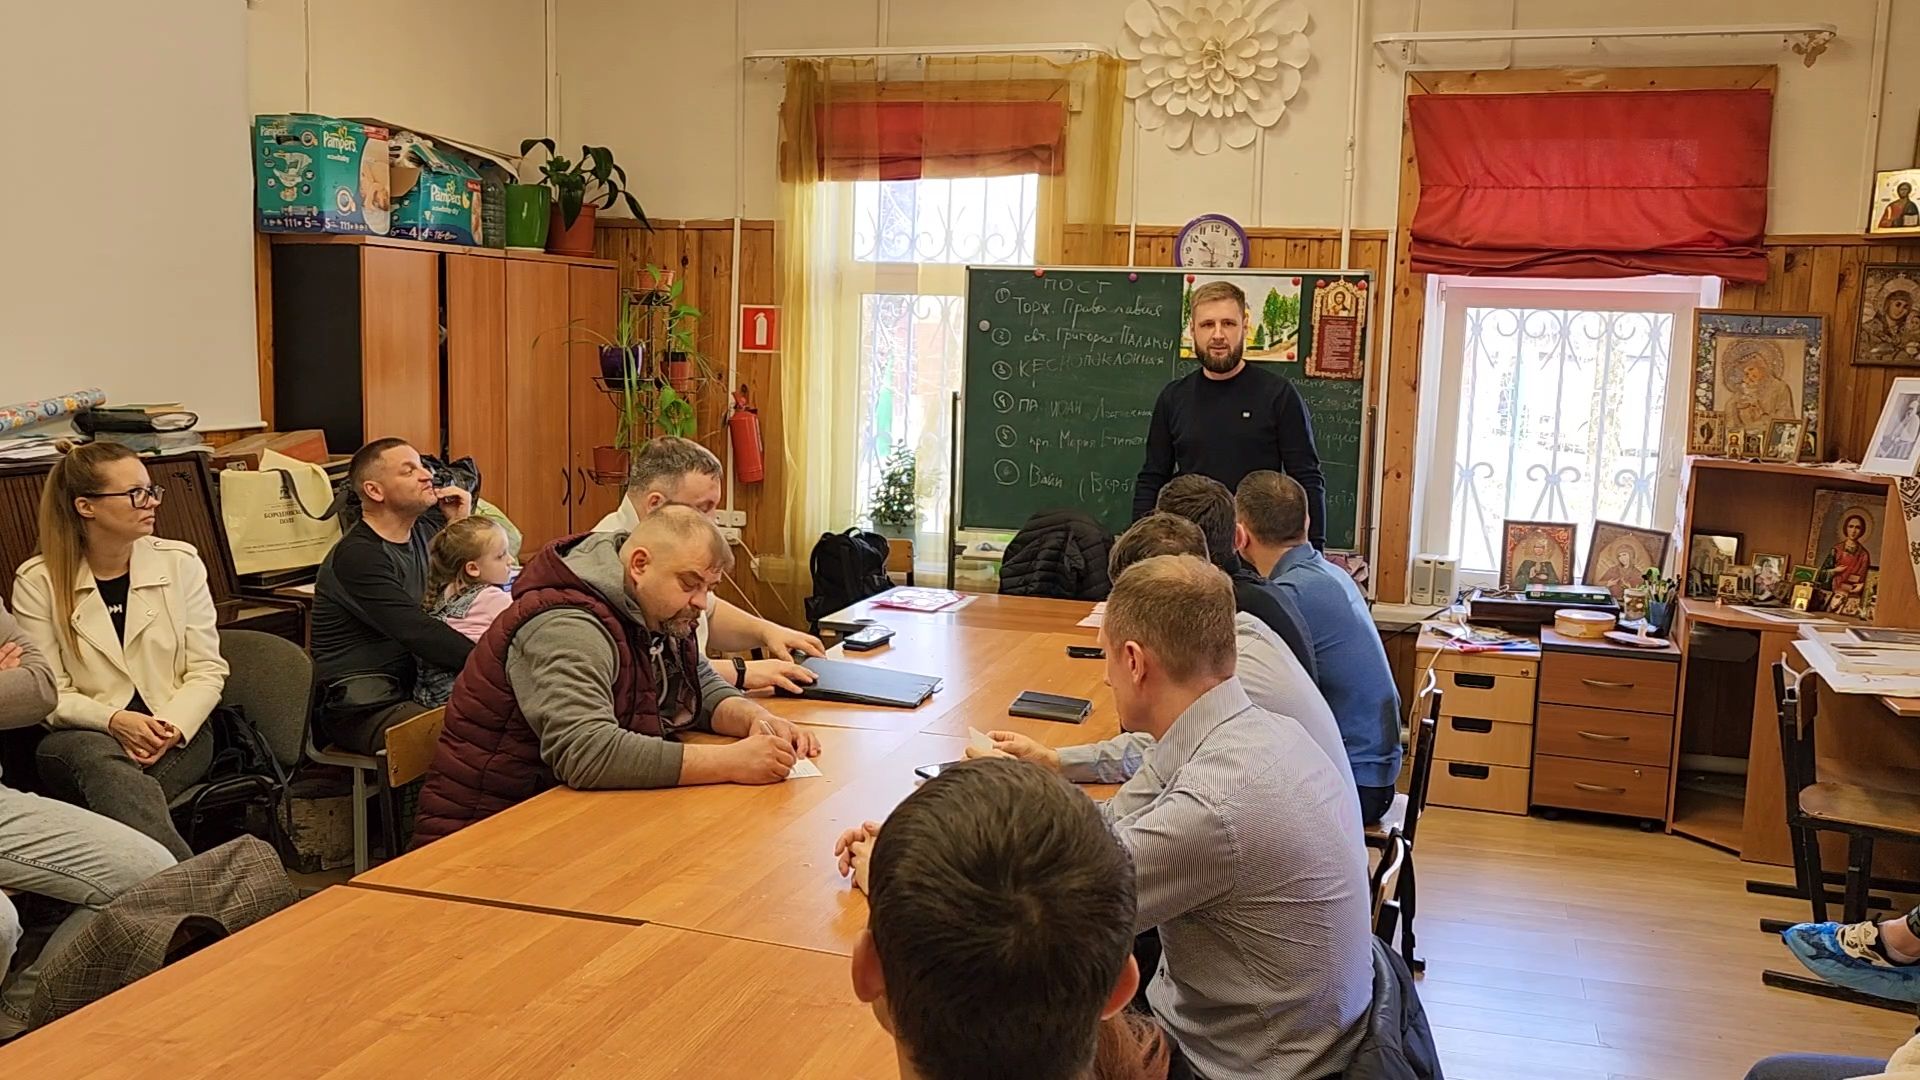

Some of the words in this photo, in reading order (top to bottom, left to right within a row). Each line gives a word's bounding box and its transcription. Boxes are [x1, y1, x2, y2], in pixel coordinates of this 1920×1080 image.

[260, 125, 288, 137] Pampers
[323, 130, 357, 154] Pampers
[430, 183, 461, 206] Pampers
[304, 217, 312, 228] 5
[324, 217, 332, 229] 5
[408, 226, 418, 238] 4
[421, 227, 430, 238] 4
[1044, 277, 1113, 295] ПОСТ
